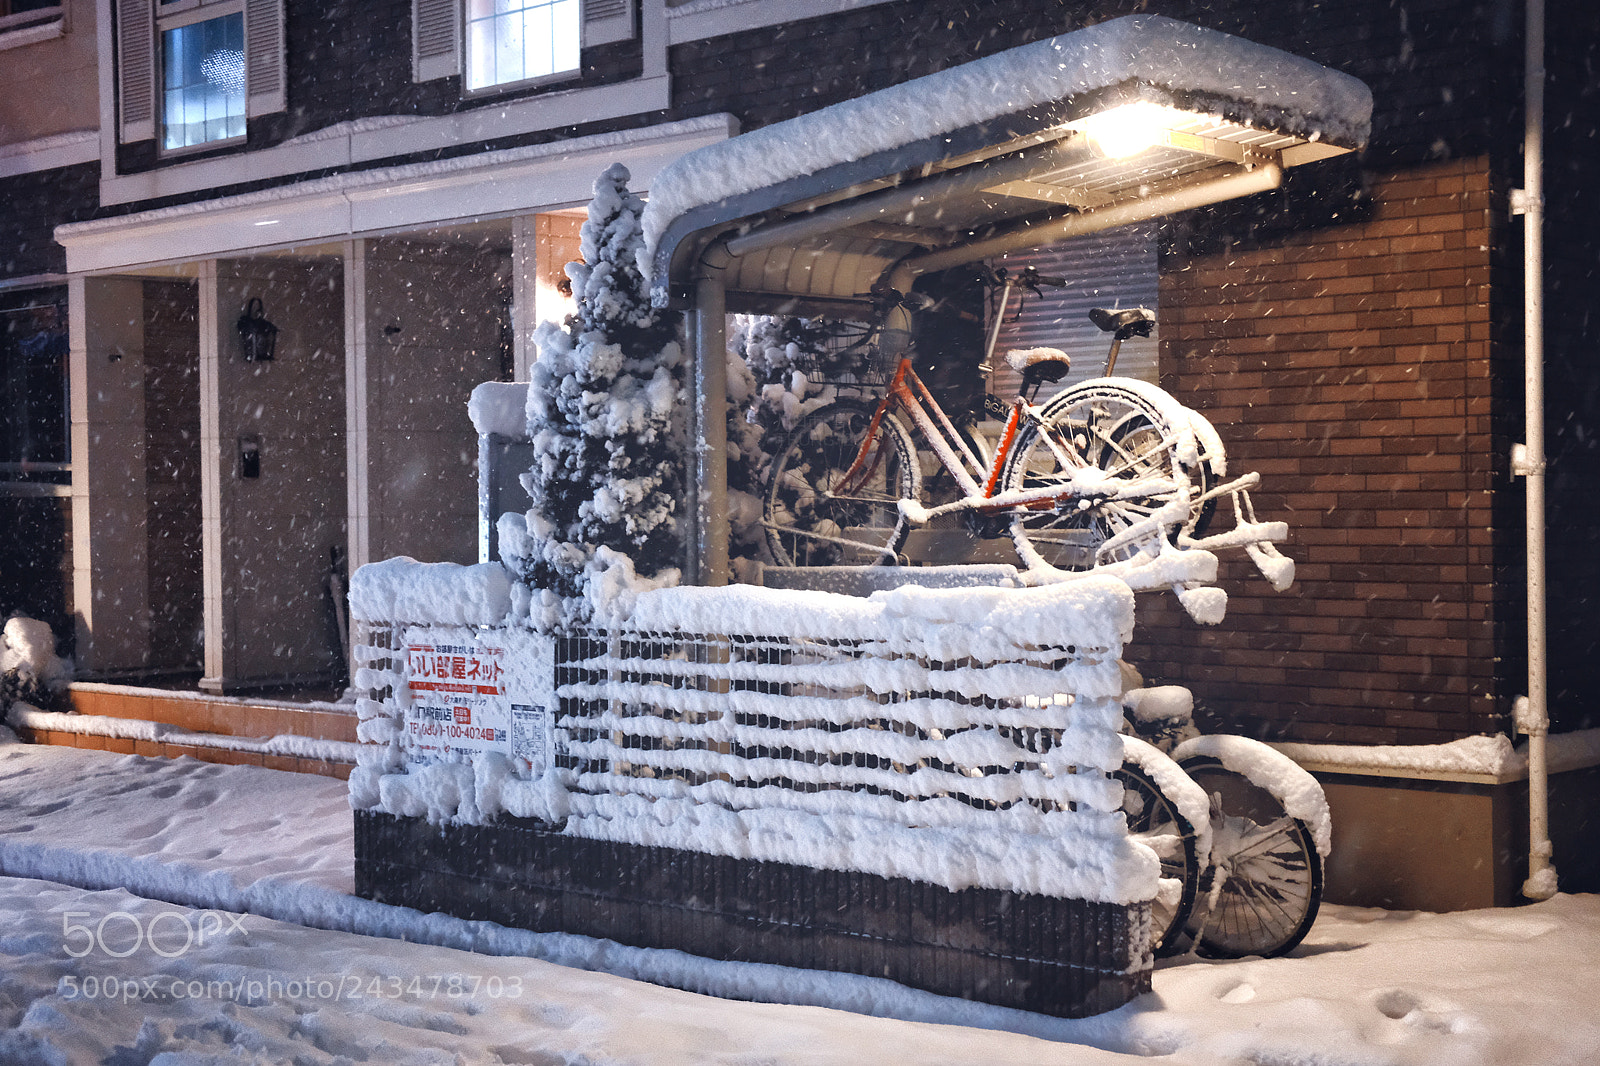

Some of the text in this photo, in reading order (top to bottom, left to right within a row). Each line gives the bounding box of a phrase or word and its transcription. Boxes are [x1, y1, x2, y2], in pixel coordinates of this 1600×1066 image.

[408, 655, 504, 681] いい部屋ネット
[409, 705, 452, 721] 口駅前店
